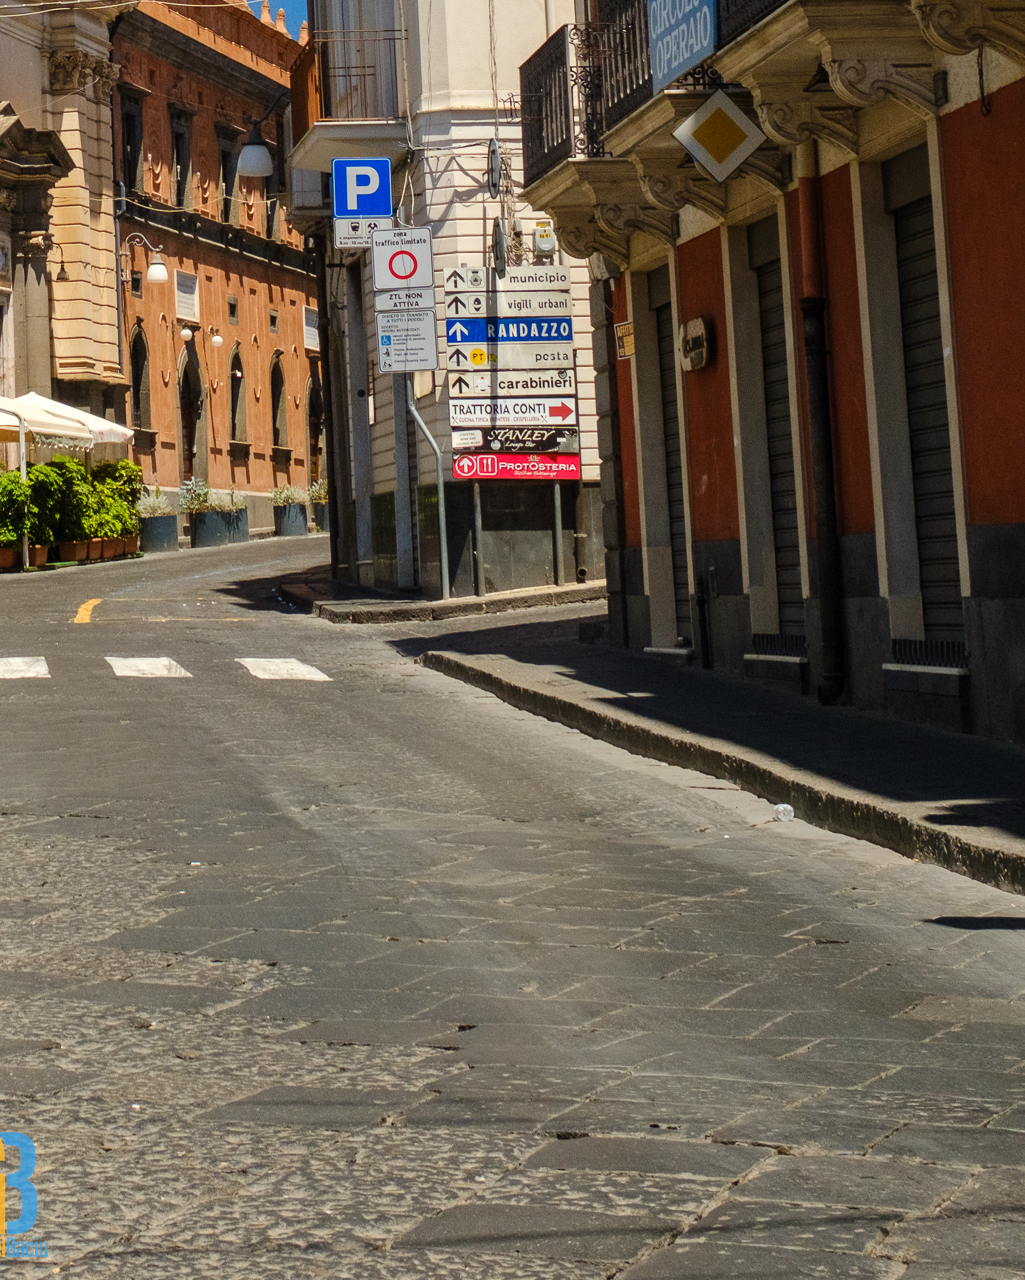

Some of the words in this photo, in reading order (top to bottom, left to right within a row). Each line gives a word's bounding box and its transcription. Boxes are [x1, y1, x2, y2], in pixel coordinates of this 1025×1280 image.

[656, 5, 711, 79] OPERAIO
[345, 166, 380, 210] P
[509, 273, 567, 284] municipio
[508, 299, 532, 311] vigili
[538, 299, 568, 309] urbani
[487, 322, 569, 338] RANDAZZO
[472, 353, 484, 361] PT
[498, 376, 572, 389] carabinieri
[452, 403, 510, 415] TRATTORIA
[513, 403, 546, 414] CONTI
[488, 428, 555, 441] STANLEY
